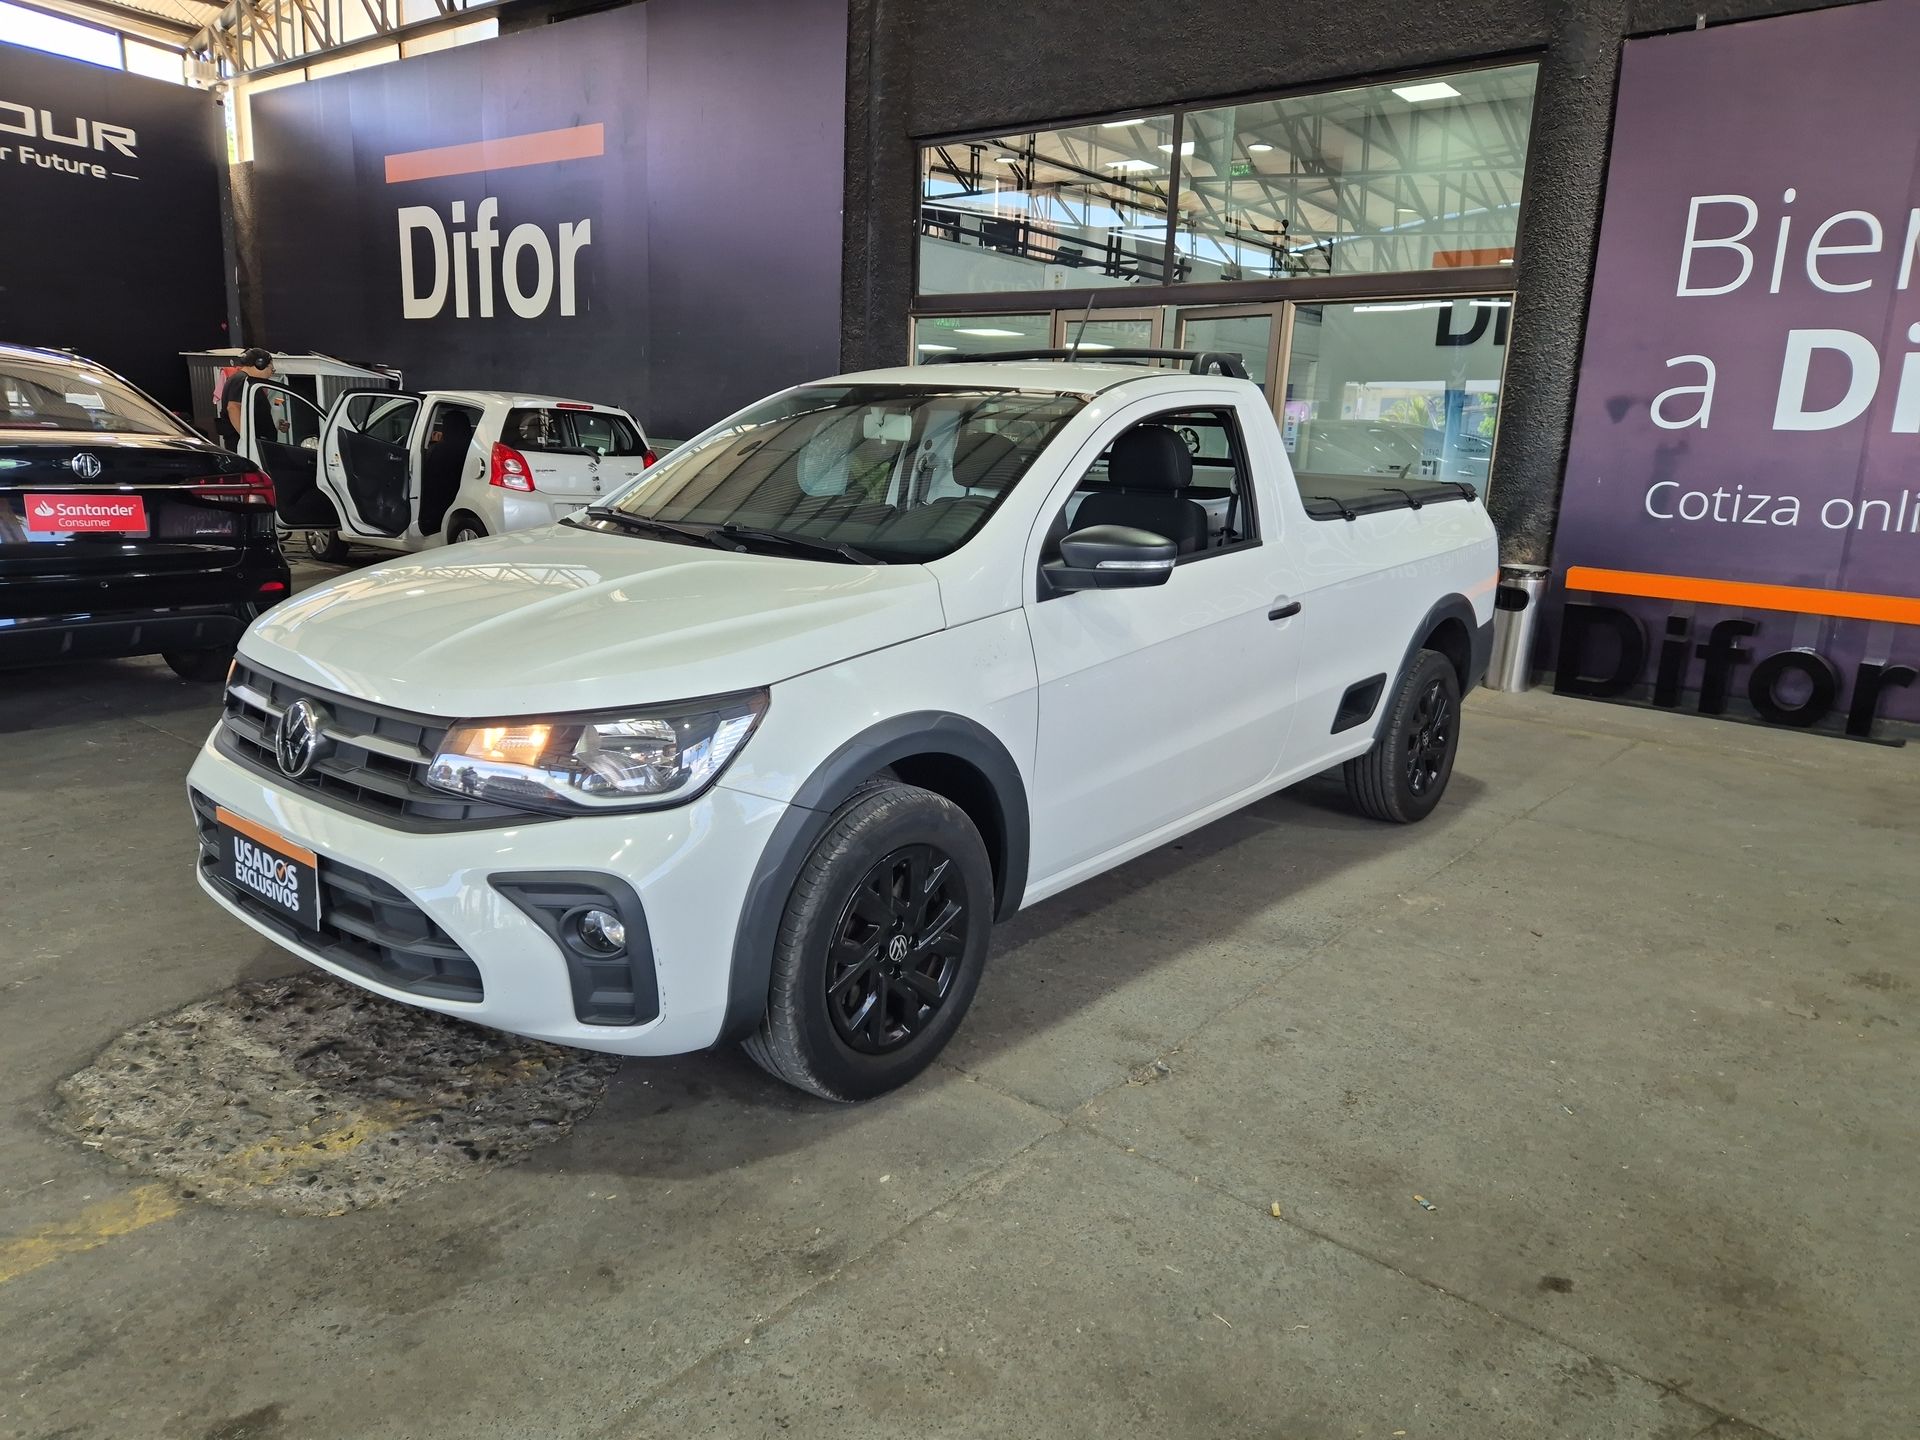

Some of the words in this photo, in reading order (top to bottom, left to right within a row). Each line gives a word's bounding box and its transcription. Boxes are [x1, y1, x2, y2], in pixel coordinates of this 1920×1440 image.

[19, 145, 108, 179] Future
[398, 196, 592, 320] Difor
[1650, 354, 1716, 430] a
[56, 503, 134, 517] Santander
[58, 518, 111, 528] Consumer
[1645, 480, 1801, 527] Cotiza
[1552, 603, 1919, 738] Difor
[233, 836, 299, 891] USADOS
[234, 861, 300, 912] EXCLUSIVOS
